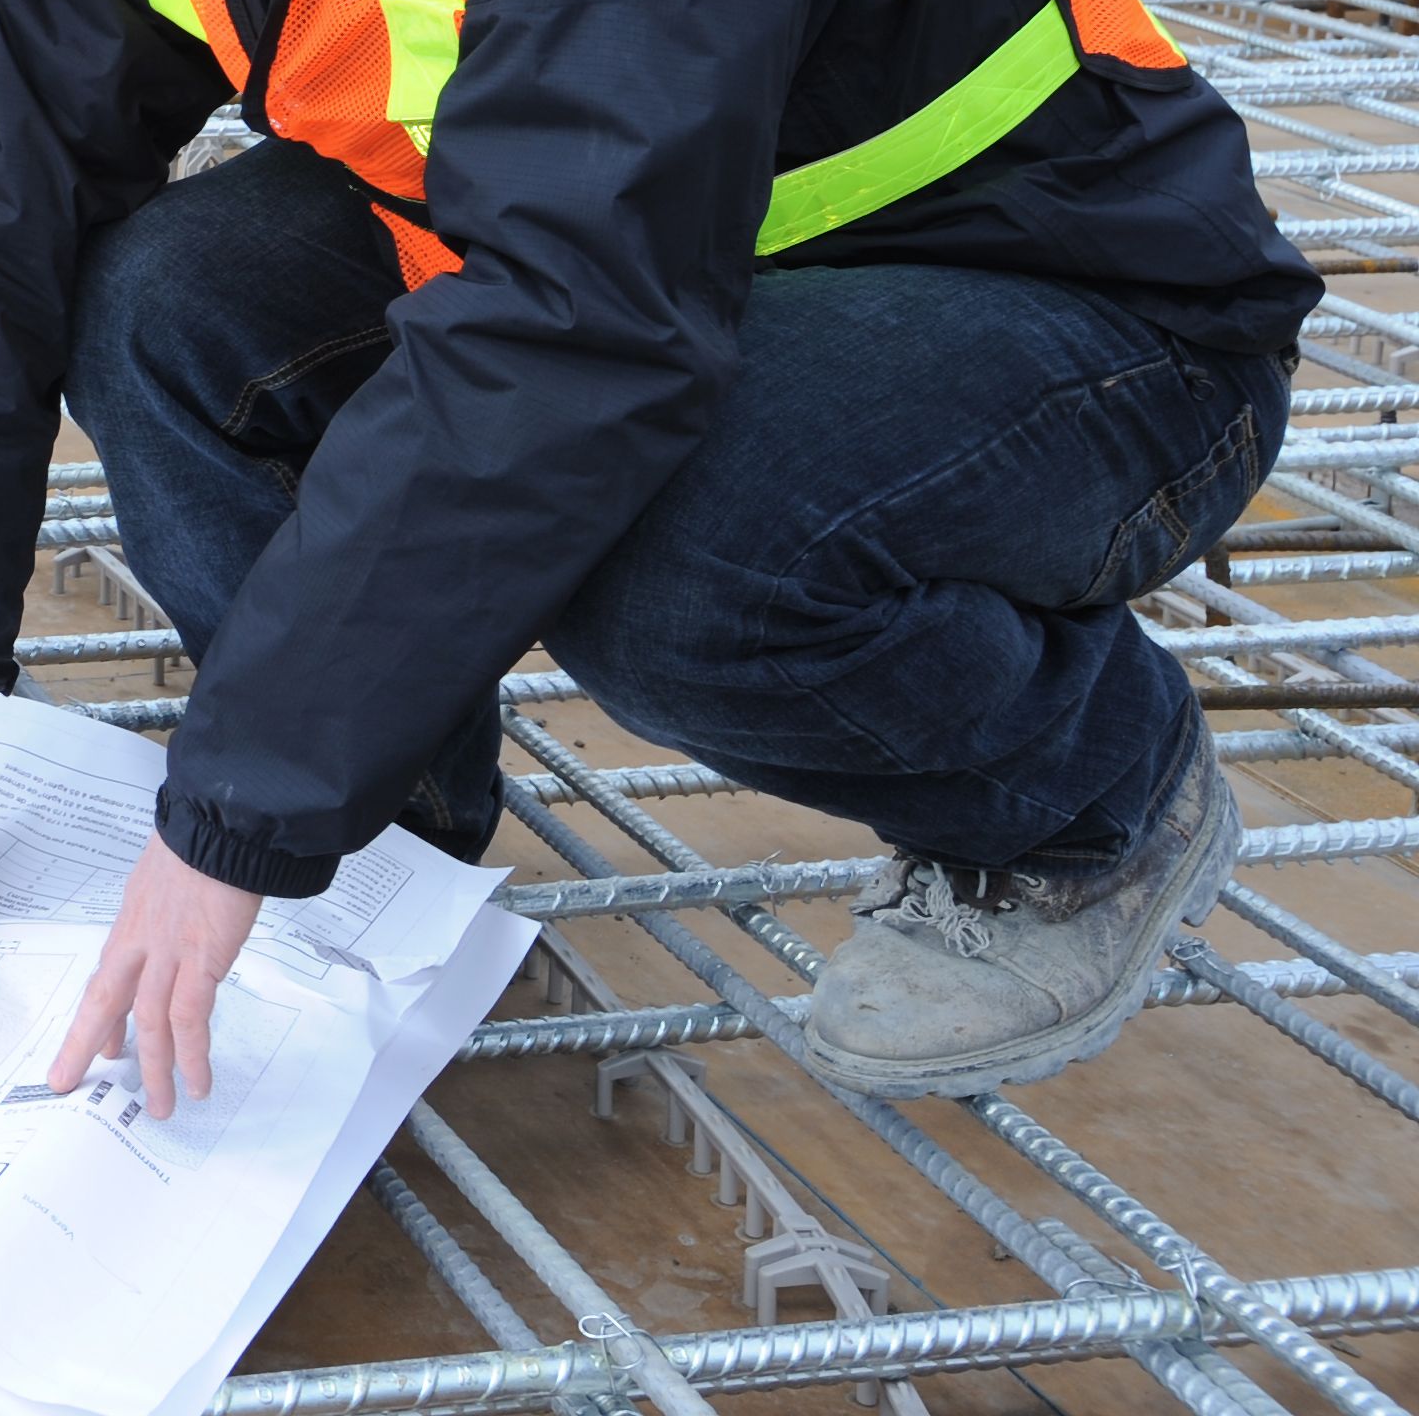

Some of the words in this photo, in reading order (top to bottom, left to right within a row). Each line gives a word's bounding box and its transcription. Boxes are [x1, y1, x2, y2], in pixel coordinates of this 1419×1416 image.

[83, 1107, 170, 1184] Thermistances
[22, 1194, 49, 1214] pont
[51, 1215, 74, 1241] Vers
